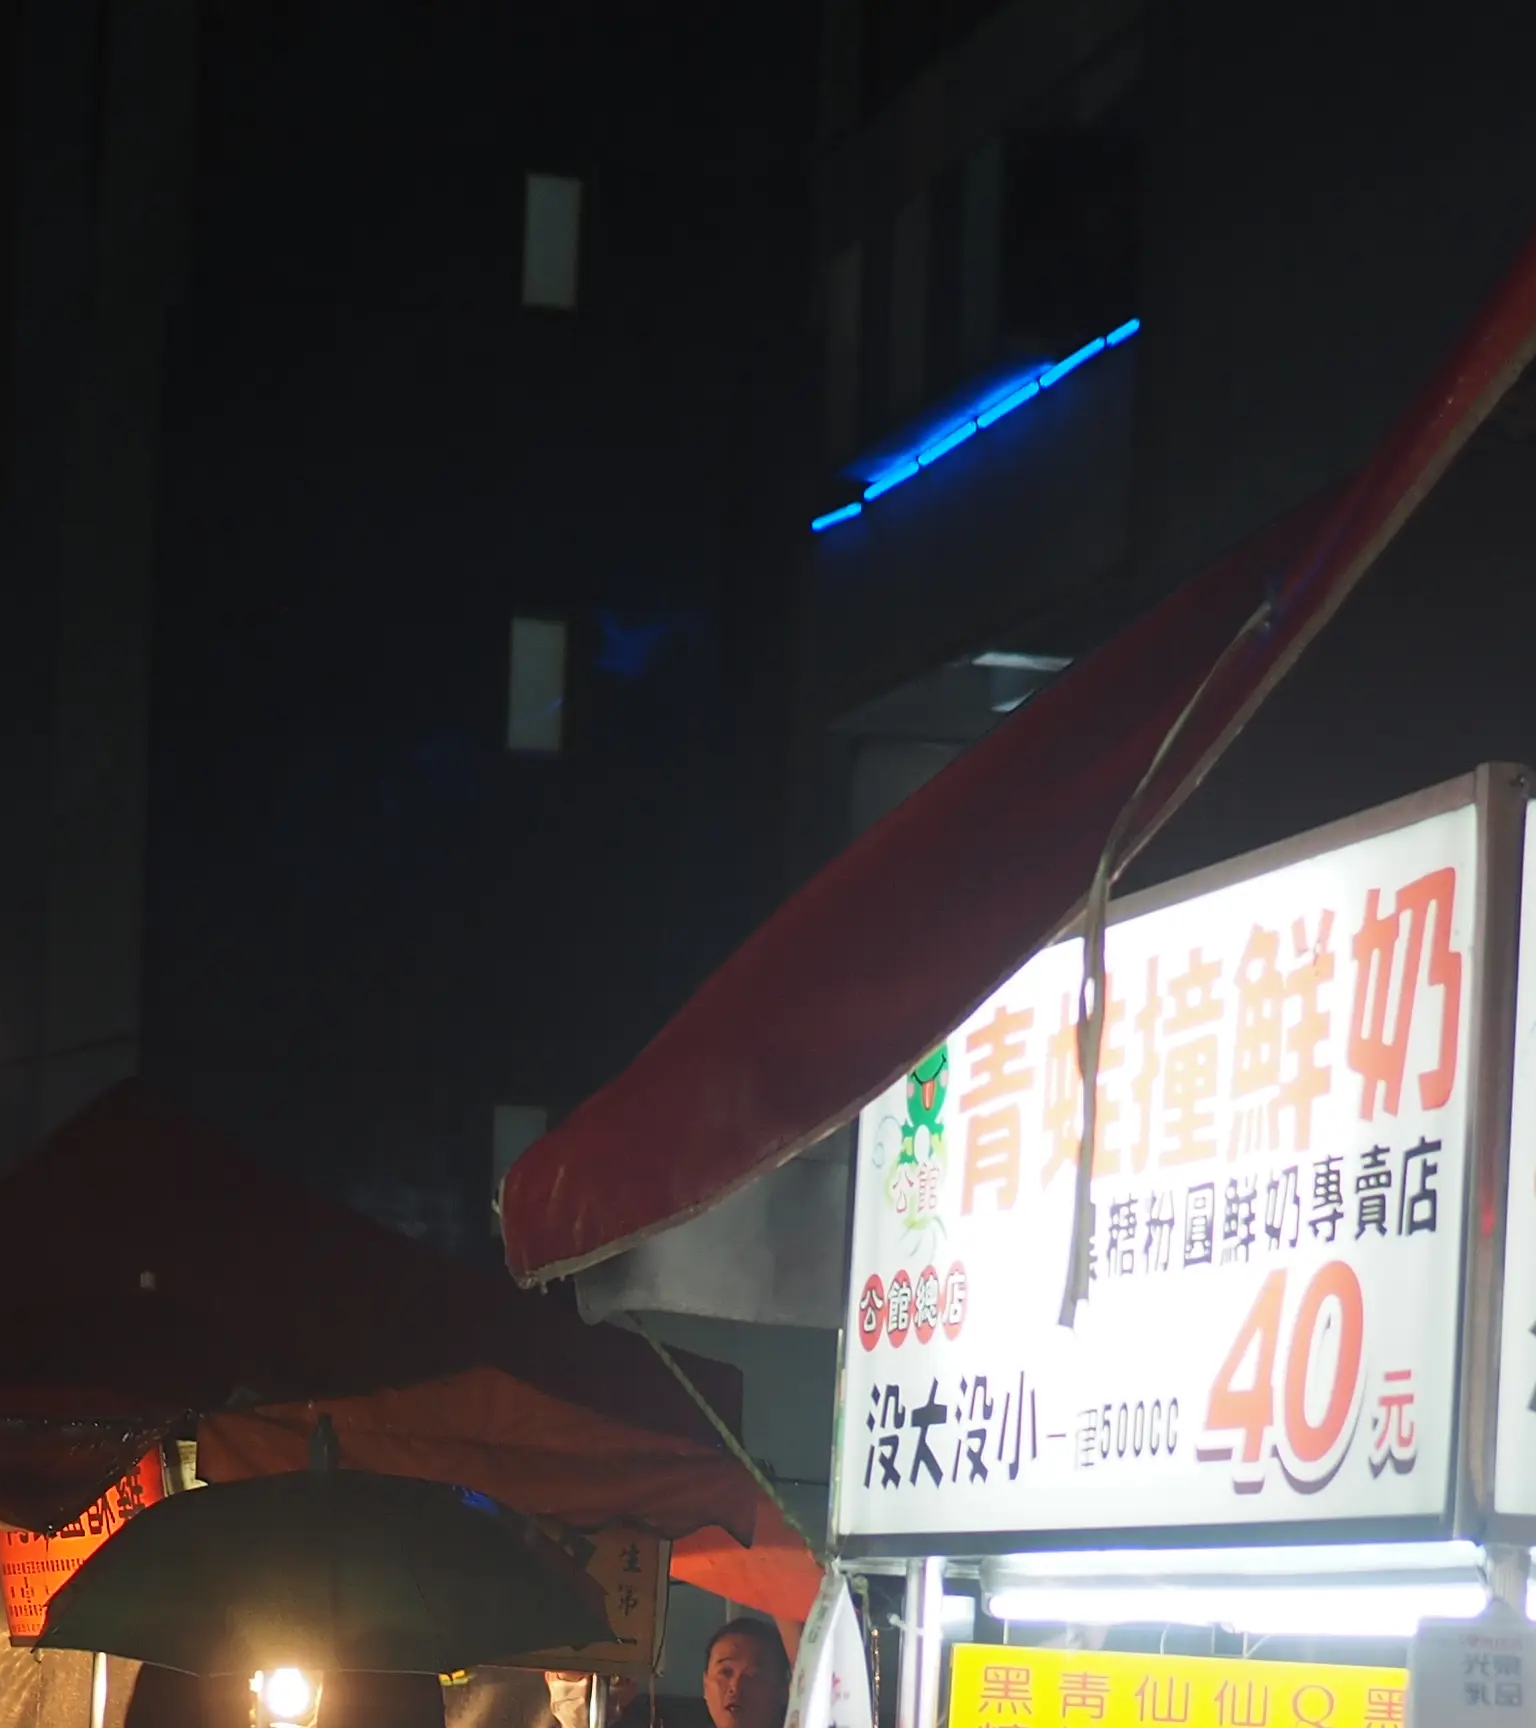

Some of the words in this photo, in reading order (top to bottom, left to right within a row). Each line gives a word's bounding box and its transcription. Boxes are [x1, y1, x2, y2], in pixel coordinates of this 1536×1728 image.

[957, 866, 1462, 1216] 青蛙撞鮮奶
[891, 1157, 940, 1216] 公館
[1088, 1136, 1443, 1283] 糖粉圓鮮奶專賣店
[858, 1268, 966, 1346] 公館總店
[1199, 1259, 1368, 1485] 40
[1374, 1368, 1416, 1470] 元
